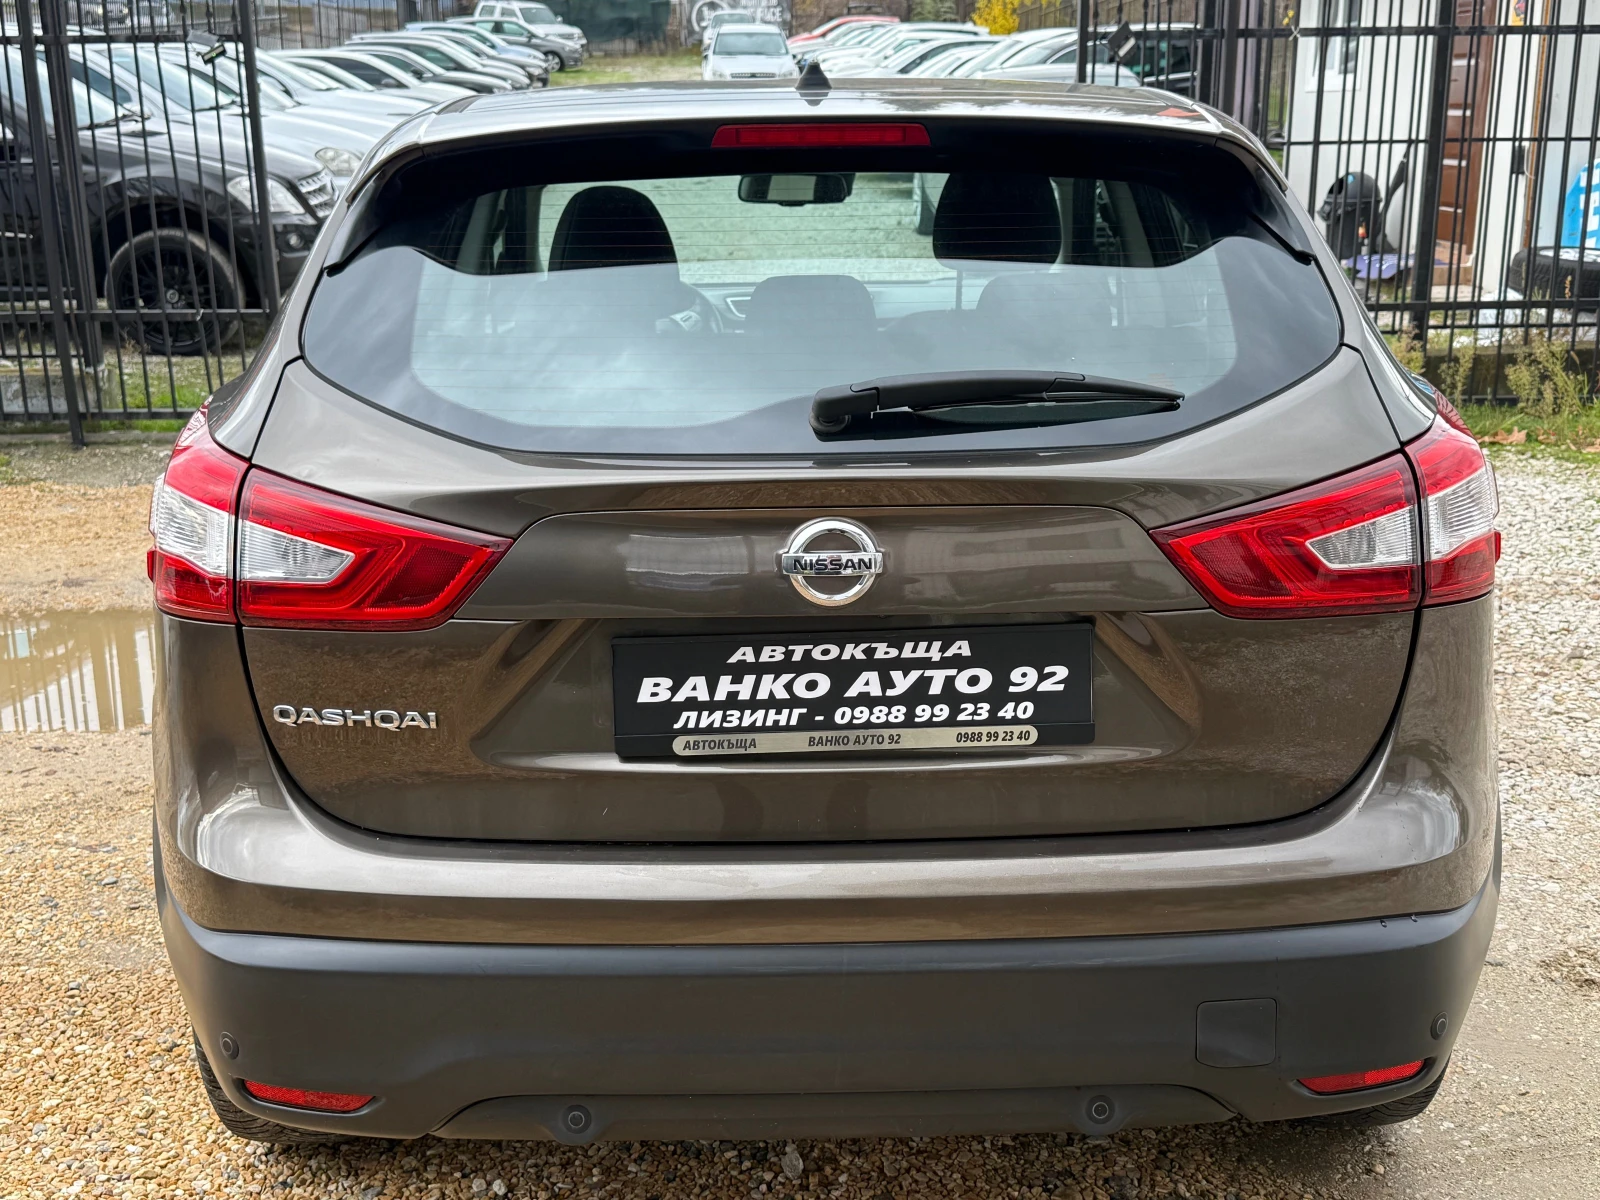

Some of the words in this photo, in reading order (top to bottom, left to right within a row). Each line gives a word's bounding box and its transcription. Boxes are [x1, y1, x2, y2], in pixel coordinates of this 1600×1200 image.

[793, 558, 872, 571] NISSAN
[726, 640, 972, 663] АВТОКЪЩА
[636, 672, 831, 703] ВАНКО
[843, 667, 993, 697] АУТО
[1008, 665, 1069, 693] 92
[272, 704, 438, 732] QASHQAI
[673, 708, 807, 729] ЛИЗИНГ
[834, 704, 907, 724] 0988
[914, 704, 950, 722] 99
[956, 702, 991, 721] 23
[997, 701, 1035, 719] 40
[682, 737, 757, 751] АВТОКЪЩА
[807, 735, 849, 747] ВАНКО
[852, 734, 885, 746] АУТО
[887, 733, 902, 745] 92
[955, 731, 983, 743] 0988
[985, 730, 999, 742] 99
[1001, 730, 1014, 741] 23
[1016, 729, 1031, 741] 40
